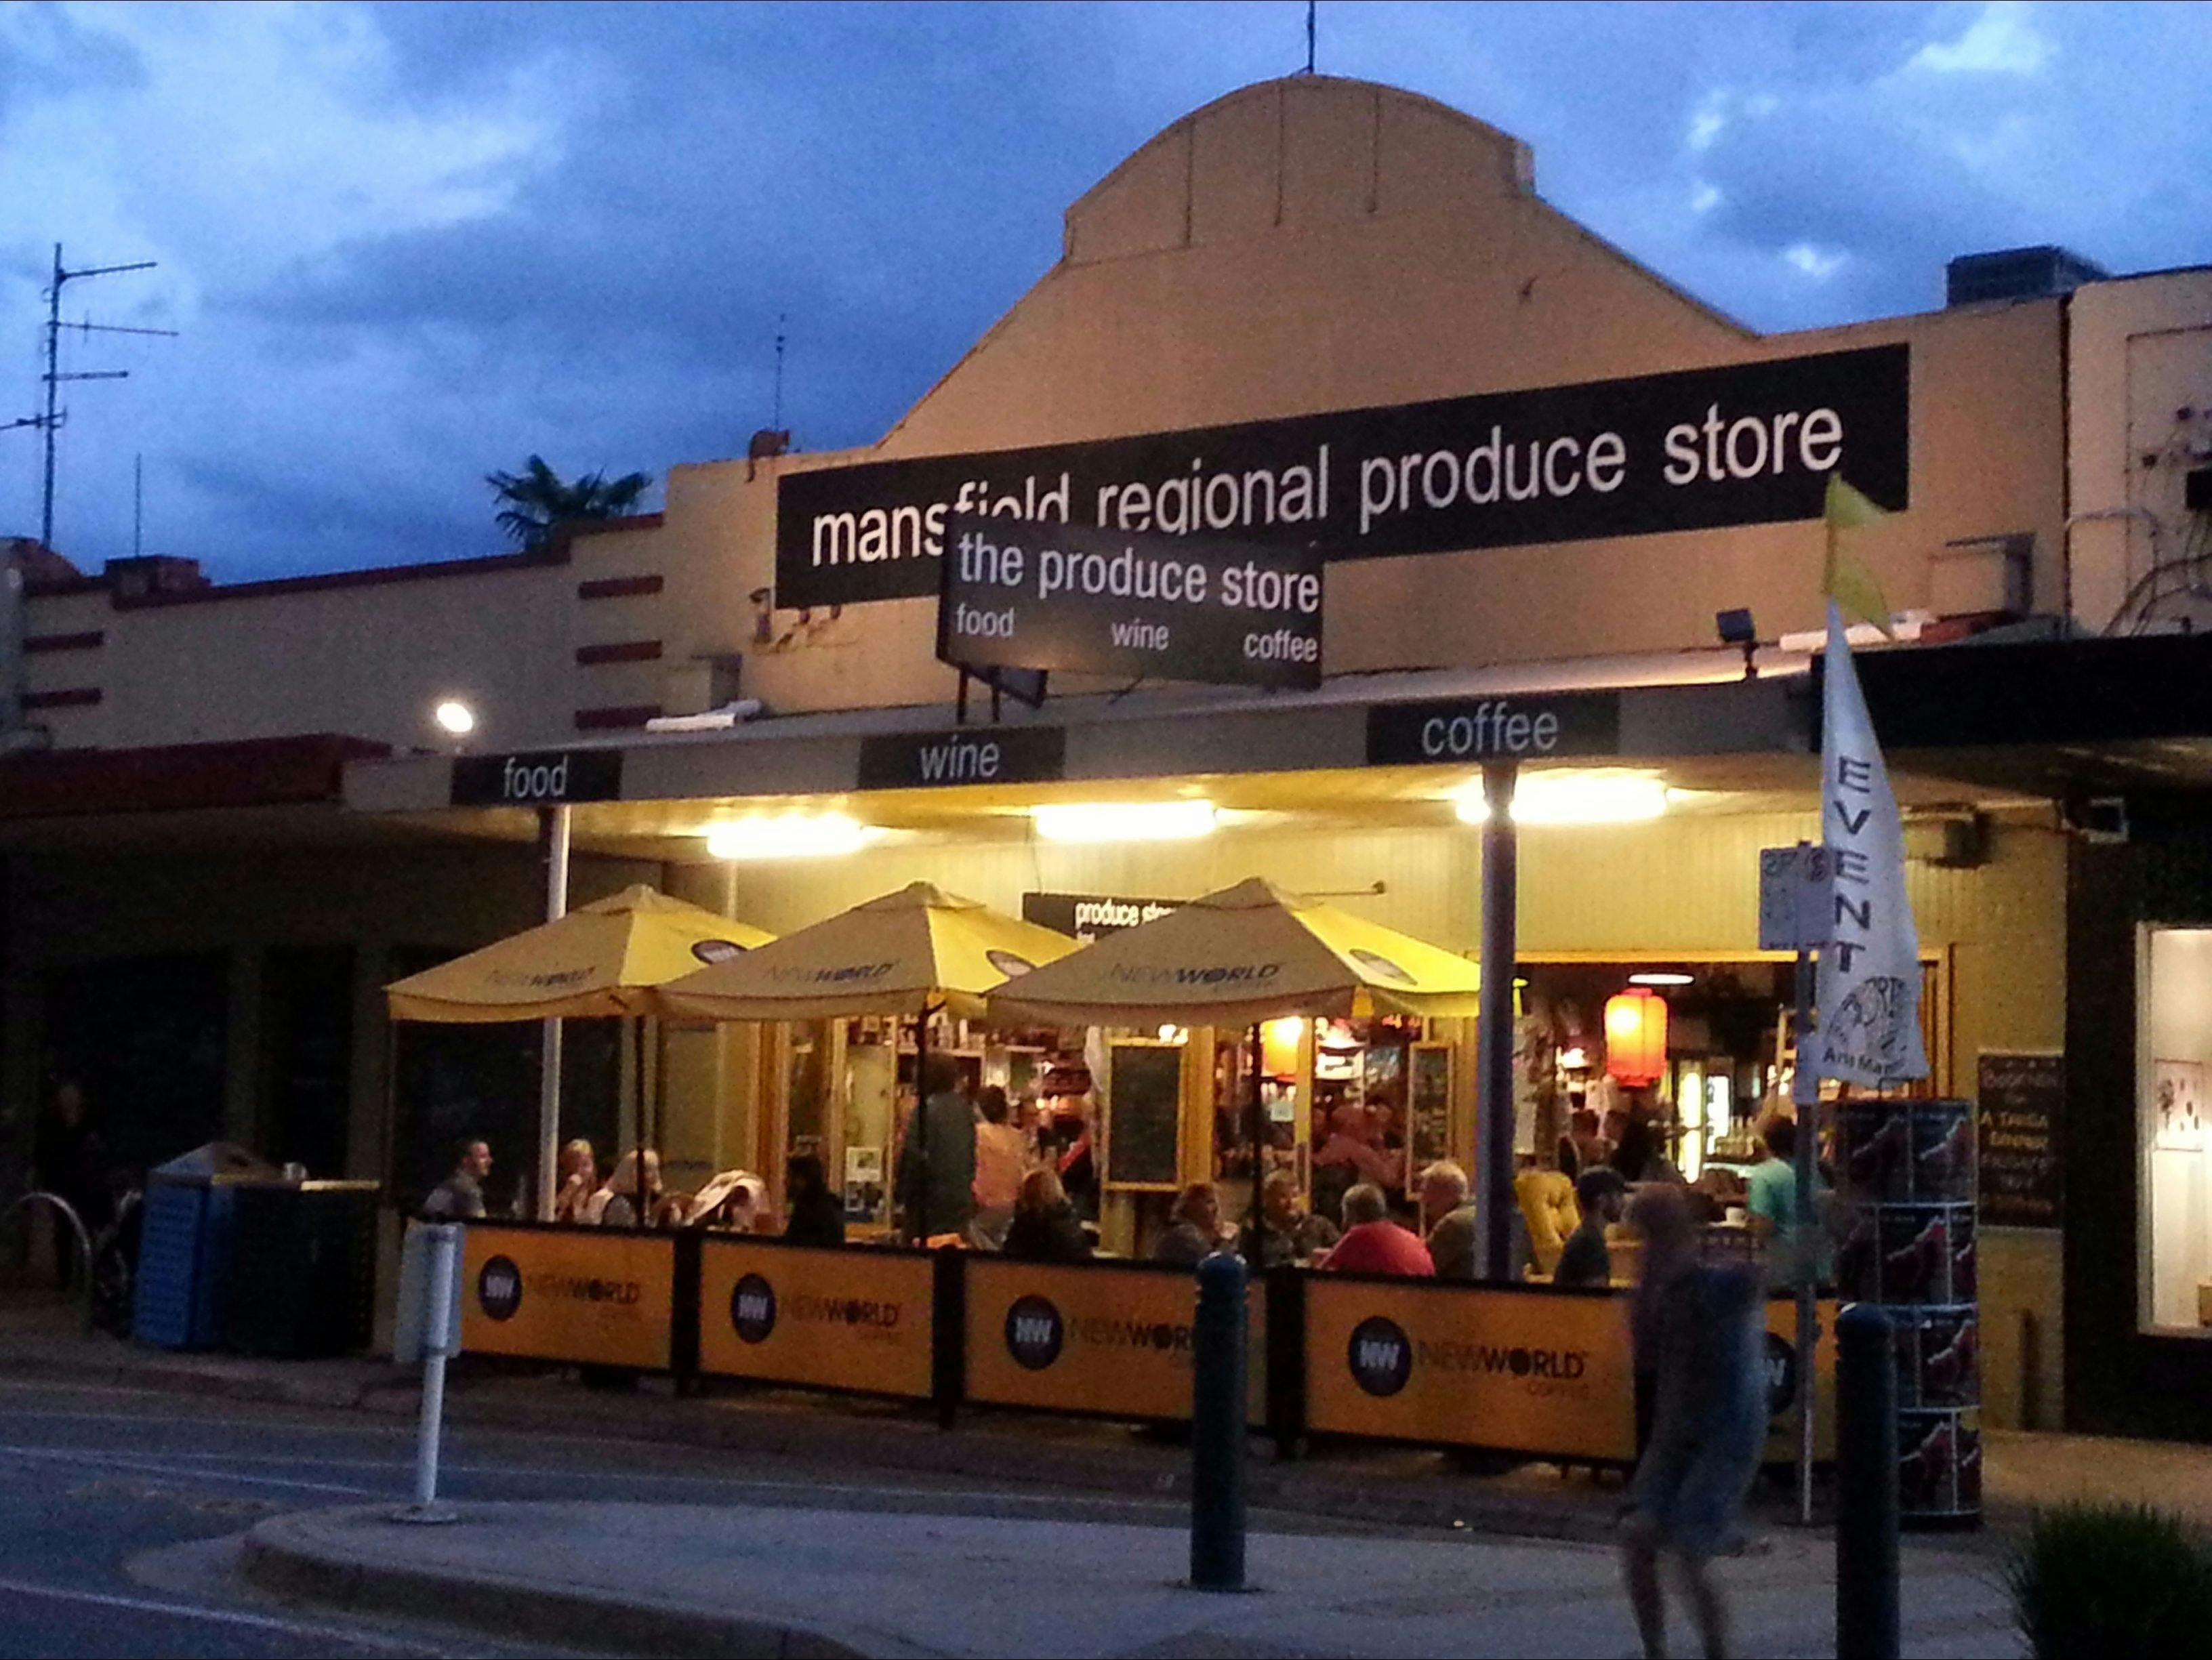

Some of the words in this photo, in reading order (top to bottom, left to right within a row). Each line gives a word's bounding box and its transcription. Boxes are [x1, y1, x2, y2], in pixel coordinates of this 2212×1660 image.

[1097, 444, 1329, 536] regional
[1359, 426, 1626, 534] produce
[1664, 403, 1843, 486] store
[958, 533, 1023, 586] the
[1039, 546, 1208, 604] produce
[1221, 561, 1319, 613] store
[957, 603, 1015, 637] food
[1111, 618, 1170, 650] wine
[1243, 629, 1318, 662] coffee
[1422, 702, 1559, 756] coffee
[920, 736, 1000, 779] wine
[504, 756, 567, 798] food
[1836, 757, 1872, 973] EVENT
[1076, 898, 1139, 930] produce
[1142, 902, 1177, 924] sto
[1016, 1316, 1052, 1344] NW
[1068, 1317, 1195, 1350] NEWWOR
[1359, 1339, 1401, 1371] NW
